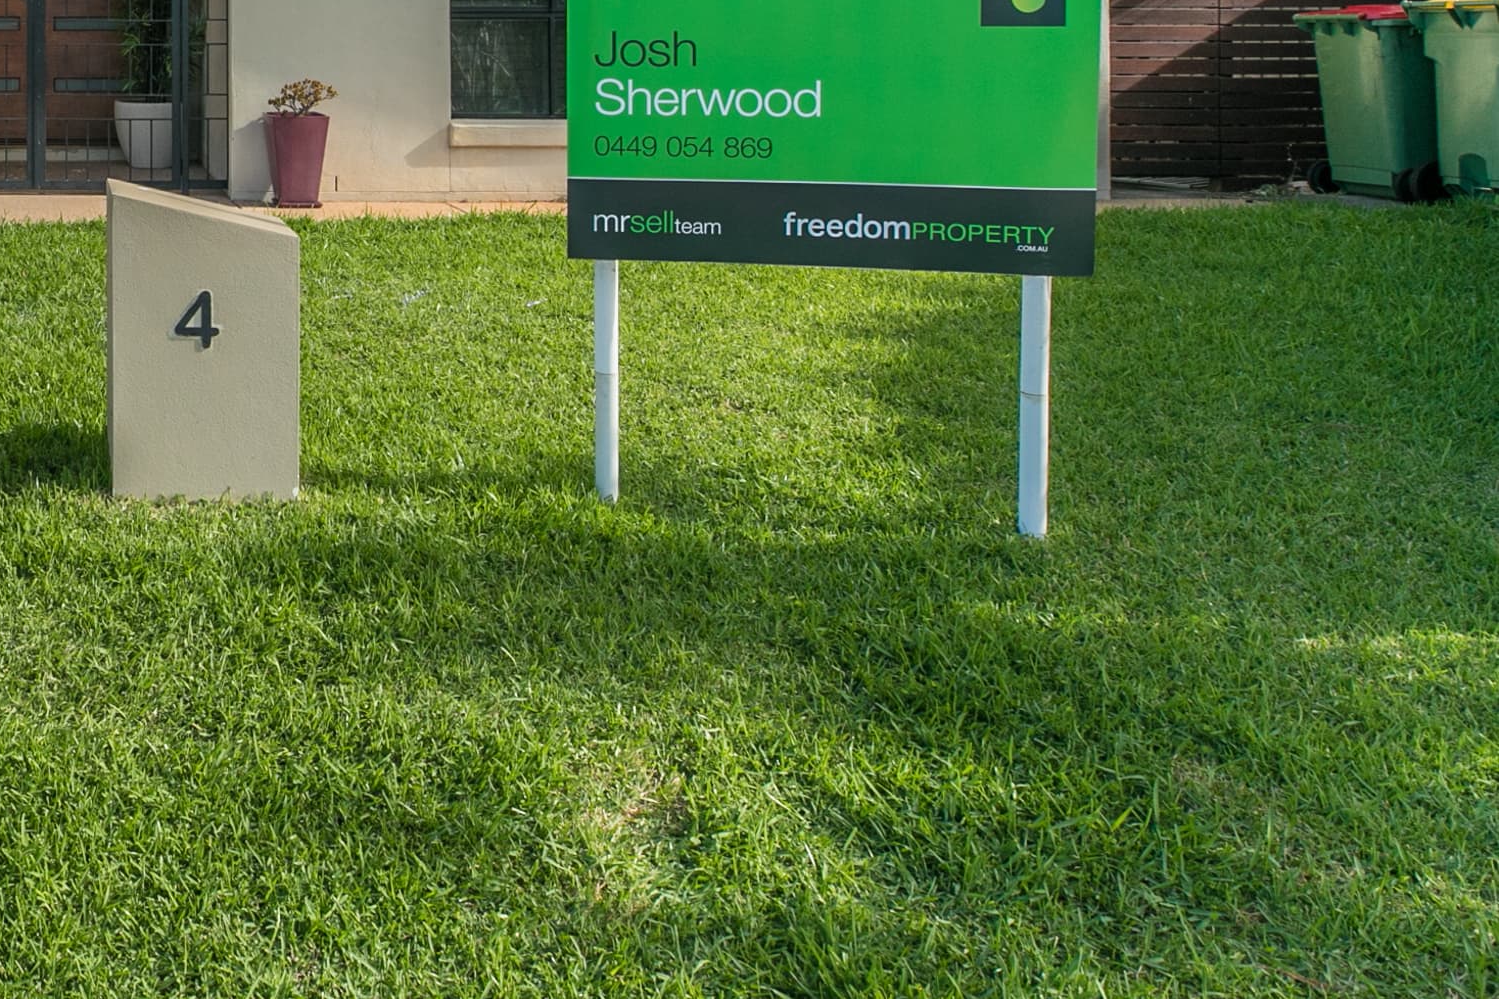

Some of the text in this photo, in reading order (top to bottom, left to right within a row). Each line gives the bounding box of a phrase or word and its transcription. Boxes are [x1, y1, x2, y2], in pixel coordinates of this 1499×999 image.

[594, 30, 697, 68] Josh
[595, 78, 822, 118] Sherwood
[594, 135, 773, 159] 0449 054 869
[174, 290, 220, 349] 4
